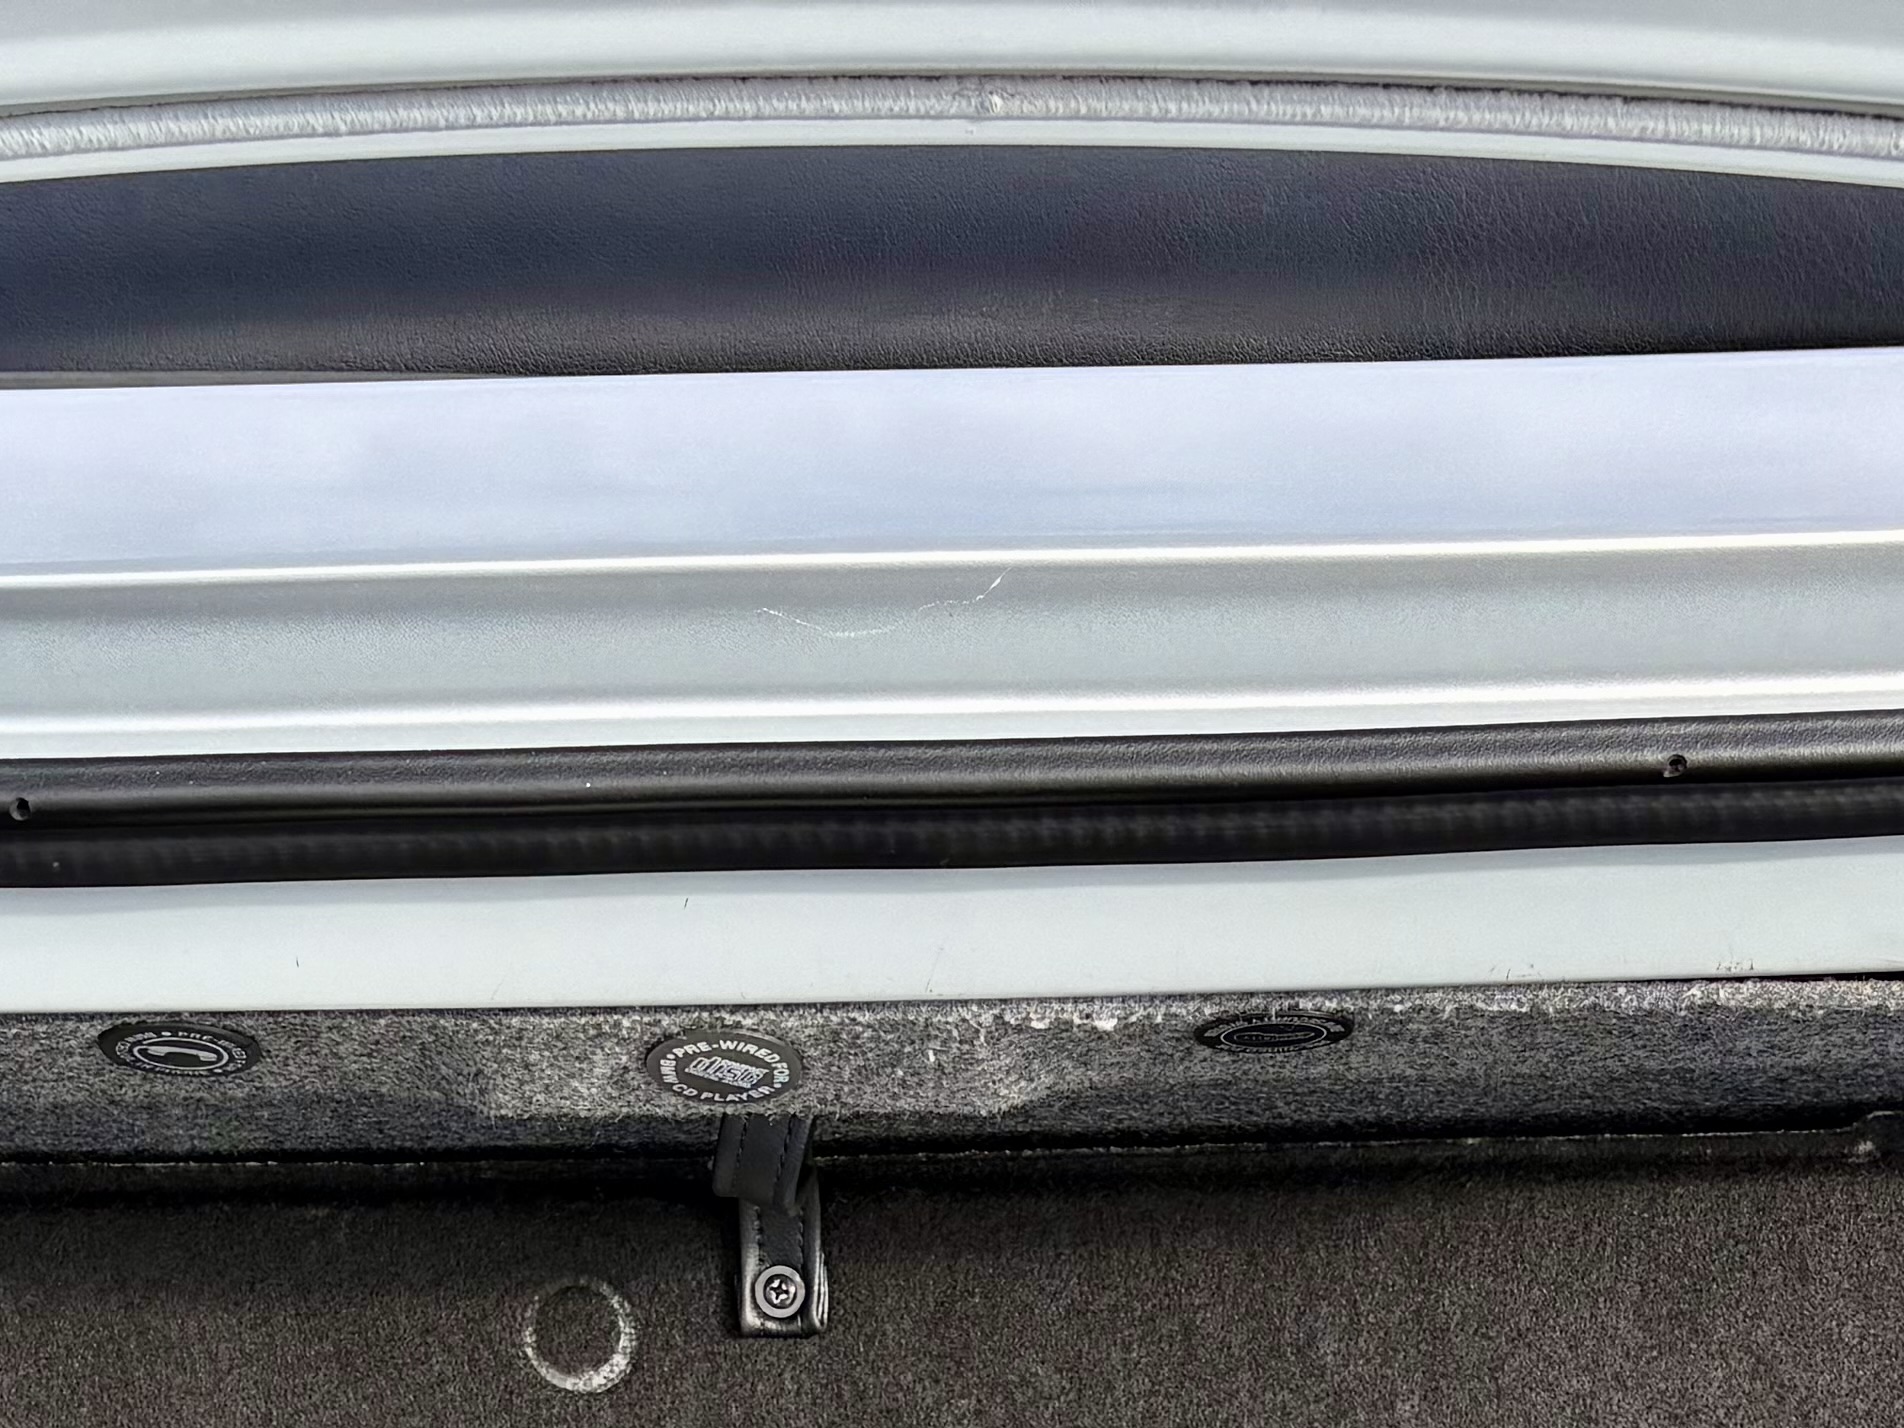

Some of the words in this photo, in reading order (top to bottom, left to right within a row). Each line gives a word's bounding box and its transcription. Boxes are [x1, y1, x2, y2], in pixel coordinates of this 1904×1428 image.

[672, 1040, 780, 1062] PRE-WIRED
[771, 1062, 790, 1084] FOR
[672, 1083, 698, 1097] CD
[700, 1085, 775, 1102] PLAYER
